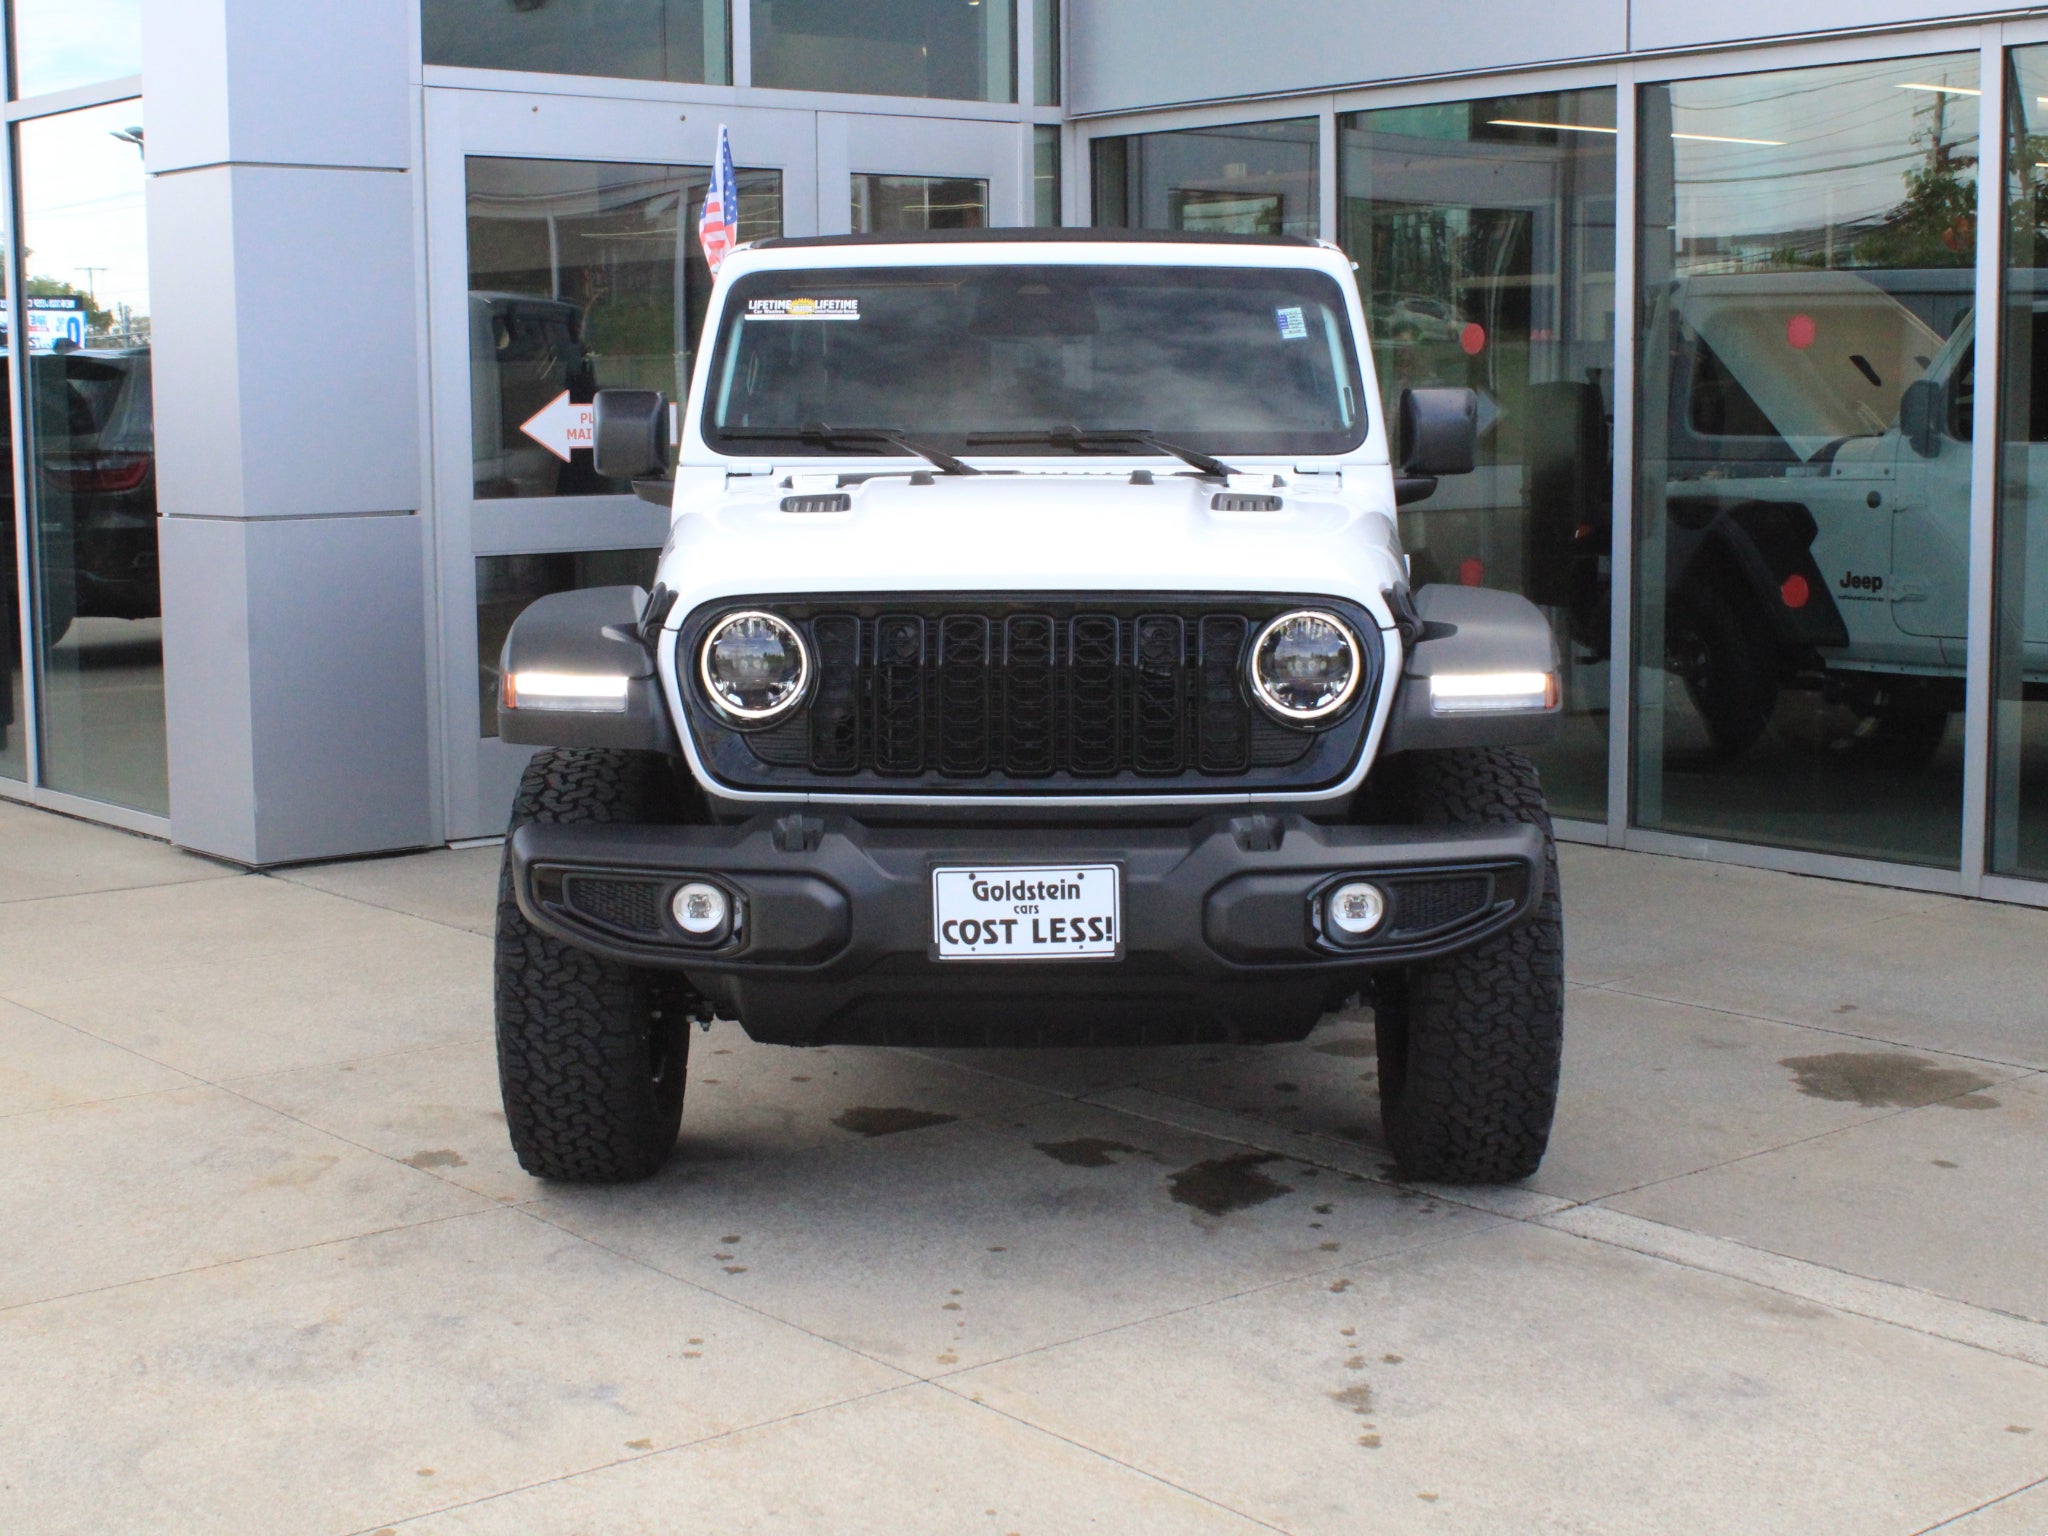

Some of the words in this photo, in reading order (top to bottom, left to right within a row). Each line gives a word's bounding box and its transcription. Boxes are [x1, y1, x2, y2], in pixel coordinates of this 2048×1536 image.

[748, 299, 792, 310] LIFETIME
[814, 299, 858, 310] LIFETIME
[566, 428, 593, 440] MAI
[1839, 571, 1883, 593] Jeep
[972, 879, 1081, 901] Goldstein
[1013, 904, 1039, 914] cars
[942, 918, 1018, 945] COST
[1032, 916, 1113, 943] LESS!
